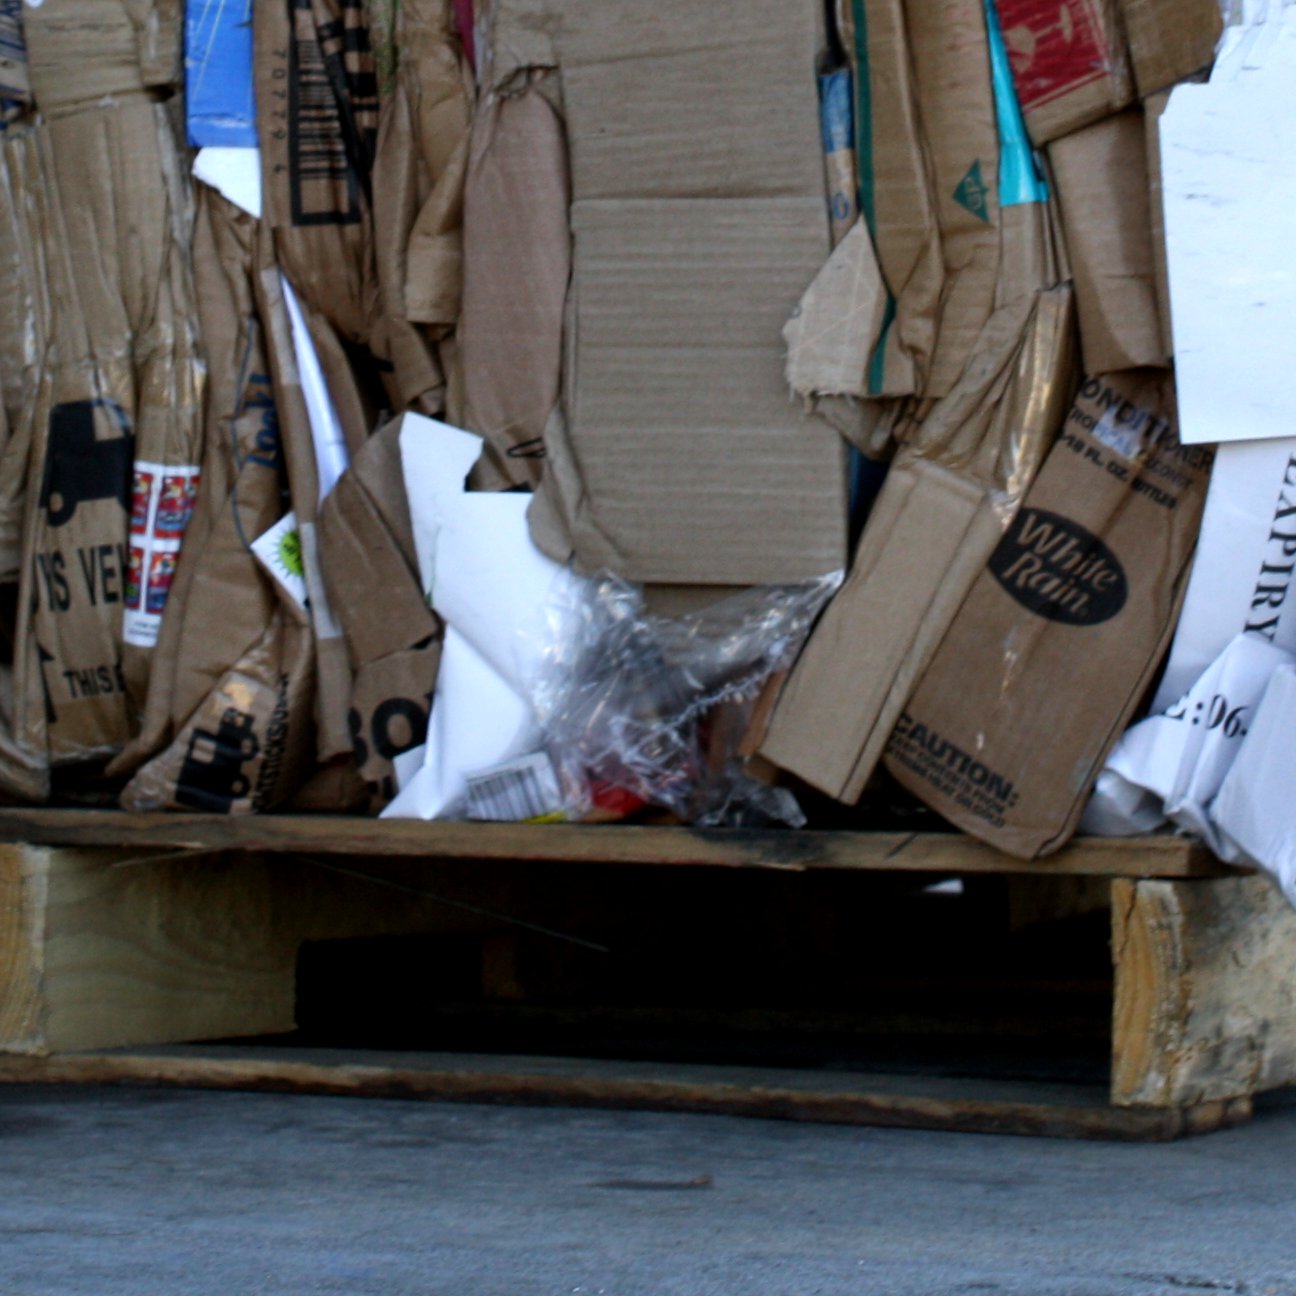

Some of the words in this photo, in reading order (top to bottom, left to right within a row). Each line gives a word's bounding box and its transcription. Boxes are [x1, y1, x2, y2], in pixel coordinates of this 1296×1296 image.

[1000, 553, 1090, 615] Rain
[1015, 513, 1118, 592] White
[63, 665, 113, 700] THIS
[893, 712, 1021, 808] CAUTION:
